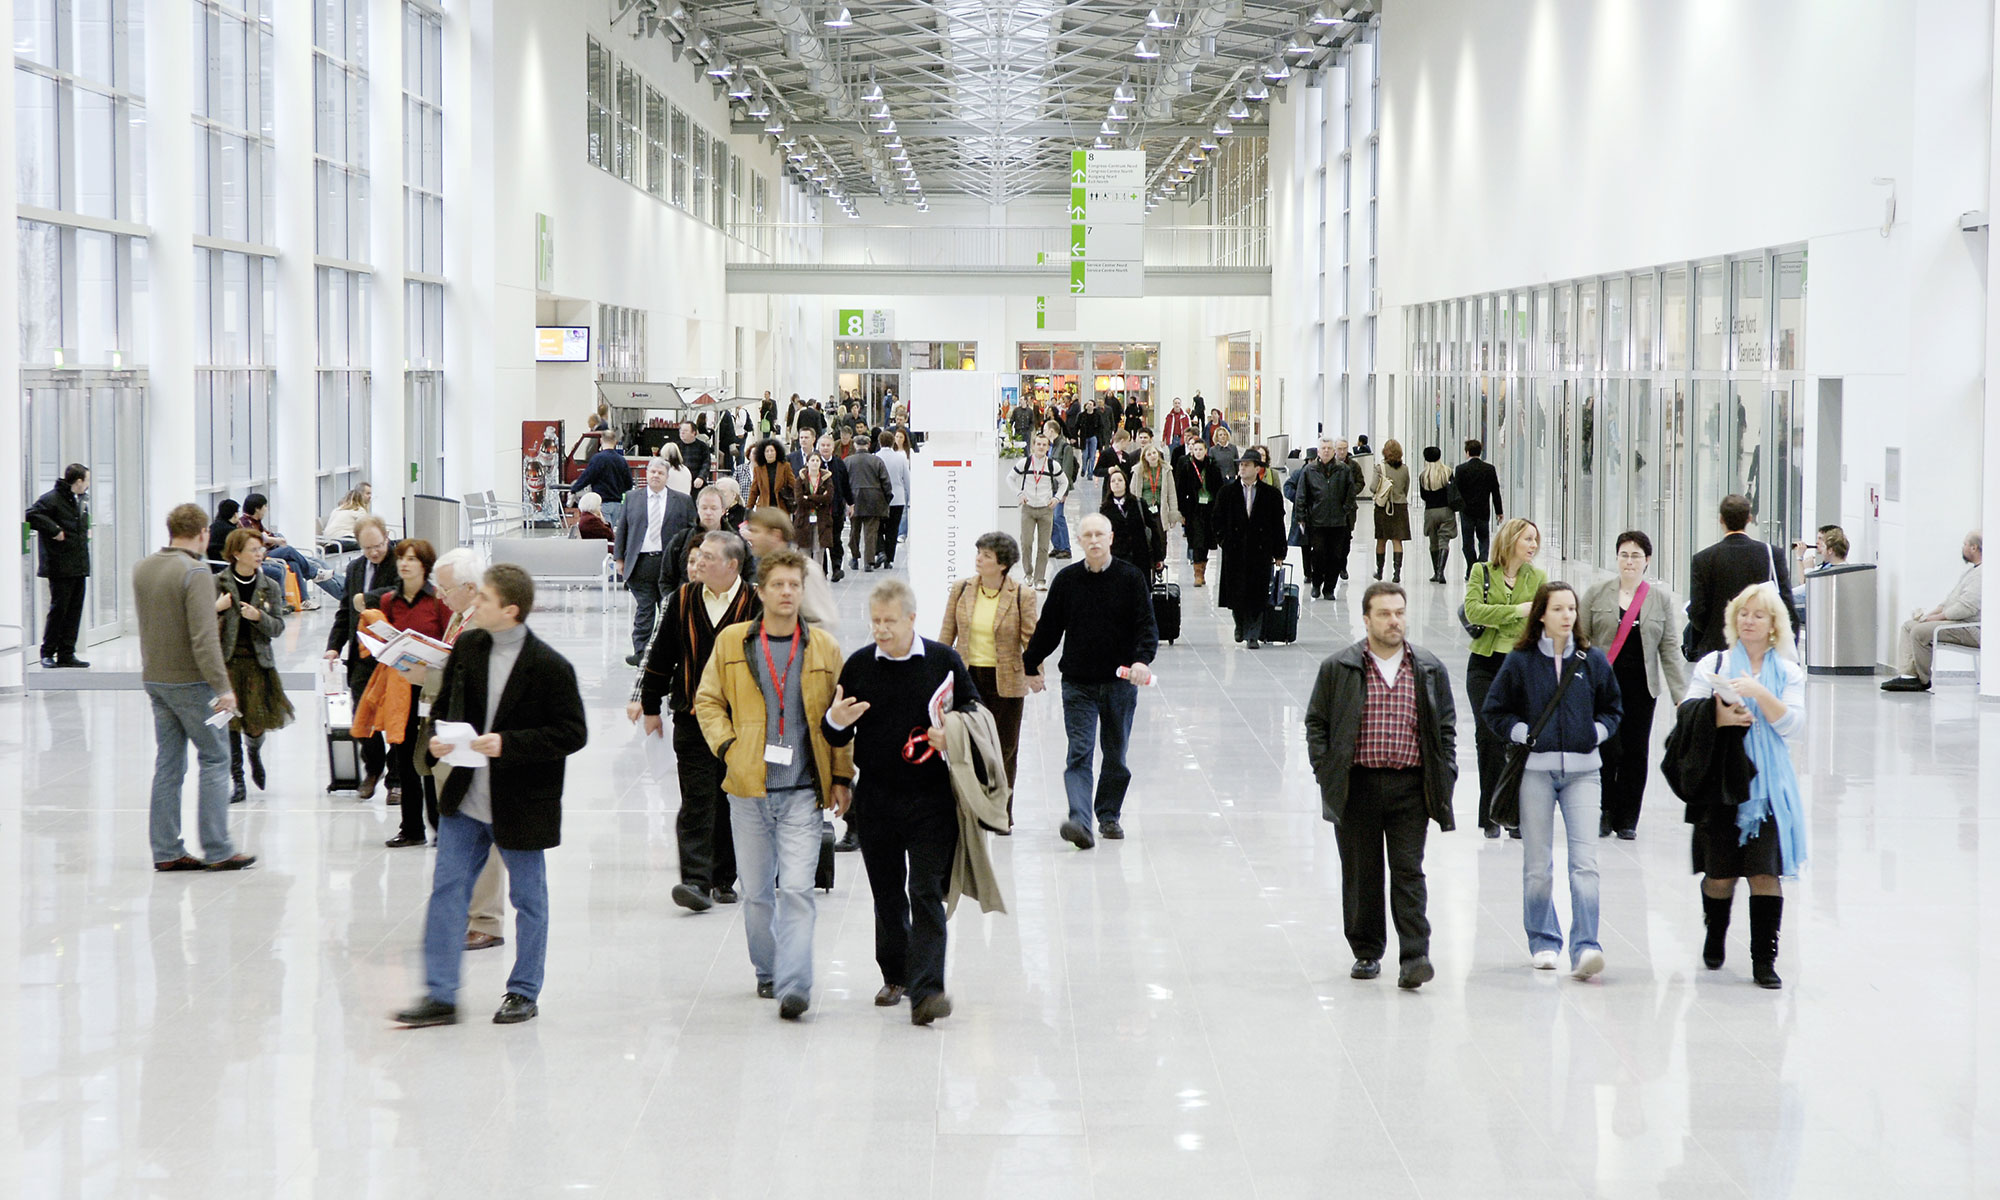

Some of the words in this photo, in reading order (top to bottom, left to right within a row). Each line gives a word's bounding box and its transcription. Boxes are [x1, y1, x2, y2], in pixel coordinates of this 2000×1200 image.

[1088, 153, 1094, 161] 8
[1087, 226, 1093, 235] 7
[847, 315, 863, 337] 8
